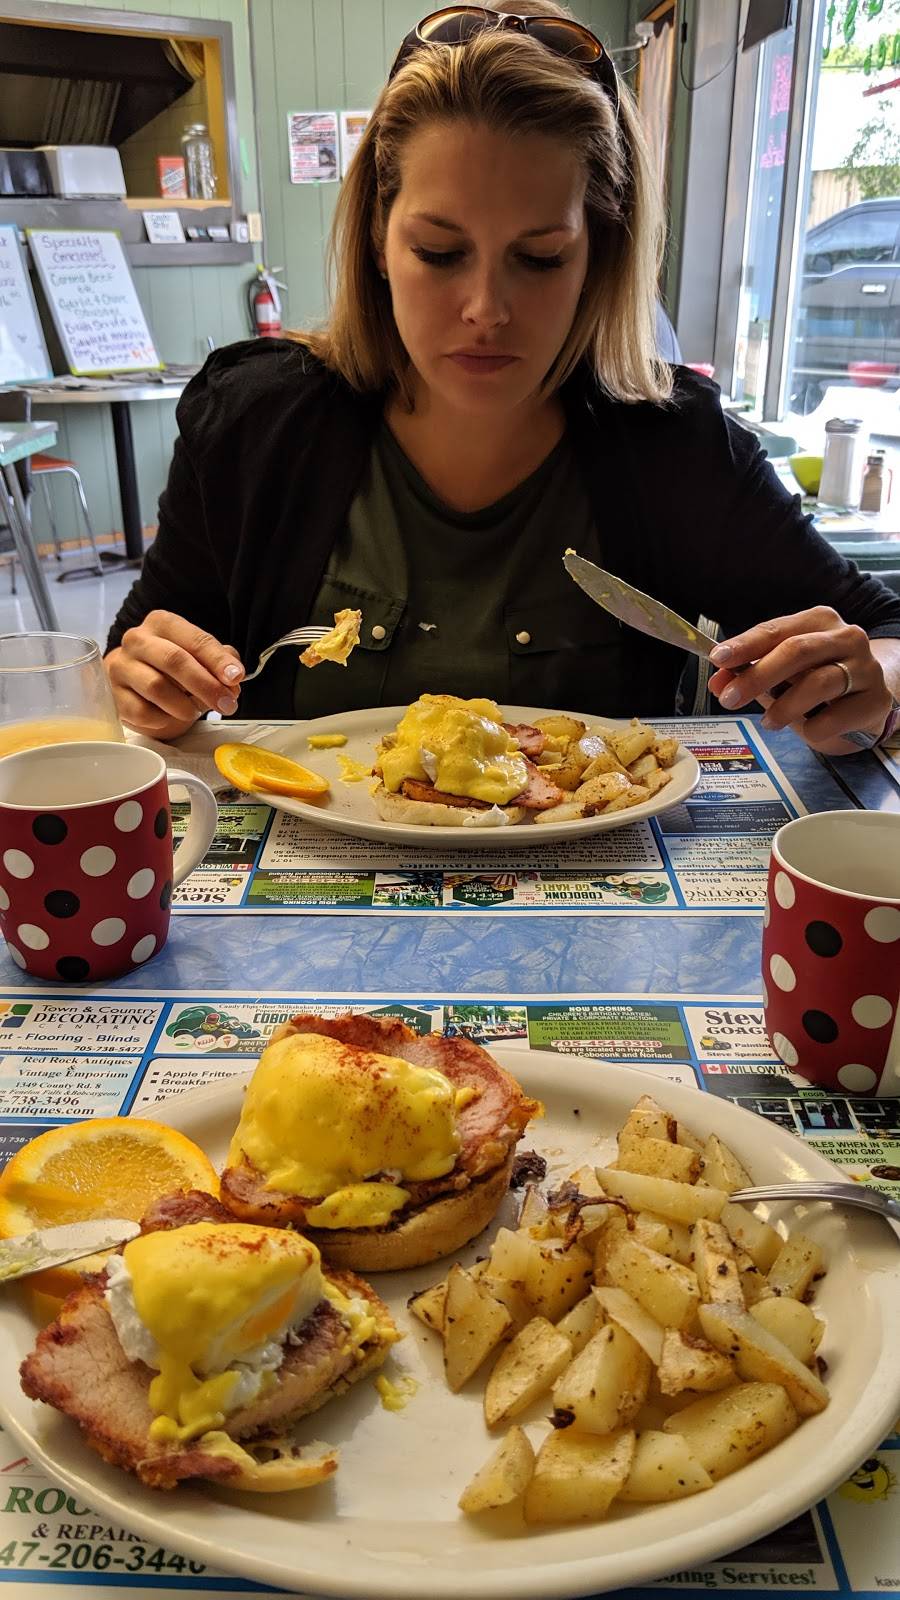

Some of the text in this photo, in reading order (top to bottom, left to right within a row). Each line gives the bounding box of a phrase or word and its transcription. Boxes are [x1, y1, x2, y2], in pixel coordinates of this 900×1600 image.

[42, 1005, 78, 1013] Town
[99, 1006, 159, 1016] Country
[33, 1013, 155, 1025] DECORATING
[25, 1033, 83, 1043] Flooring
[96, 1035, 141, 1043] Blinds
[23, 1056, 134, 1066] Red Rock Antiques
[18, 1069, 129, 1079] Vintage Emporium
[727, 1065, 777, 1074] WILLOW
[31, 1523, 151, 1544] & REPAIR
[722, 1567, 817, 1586] Services!
